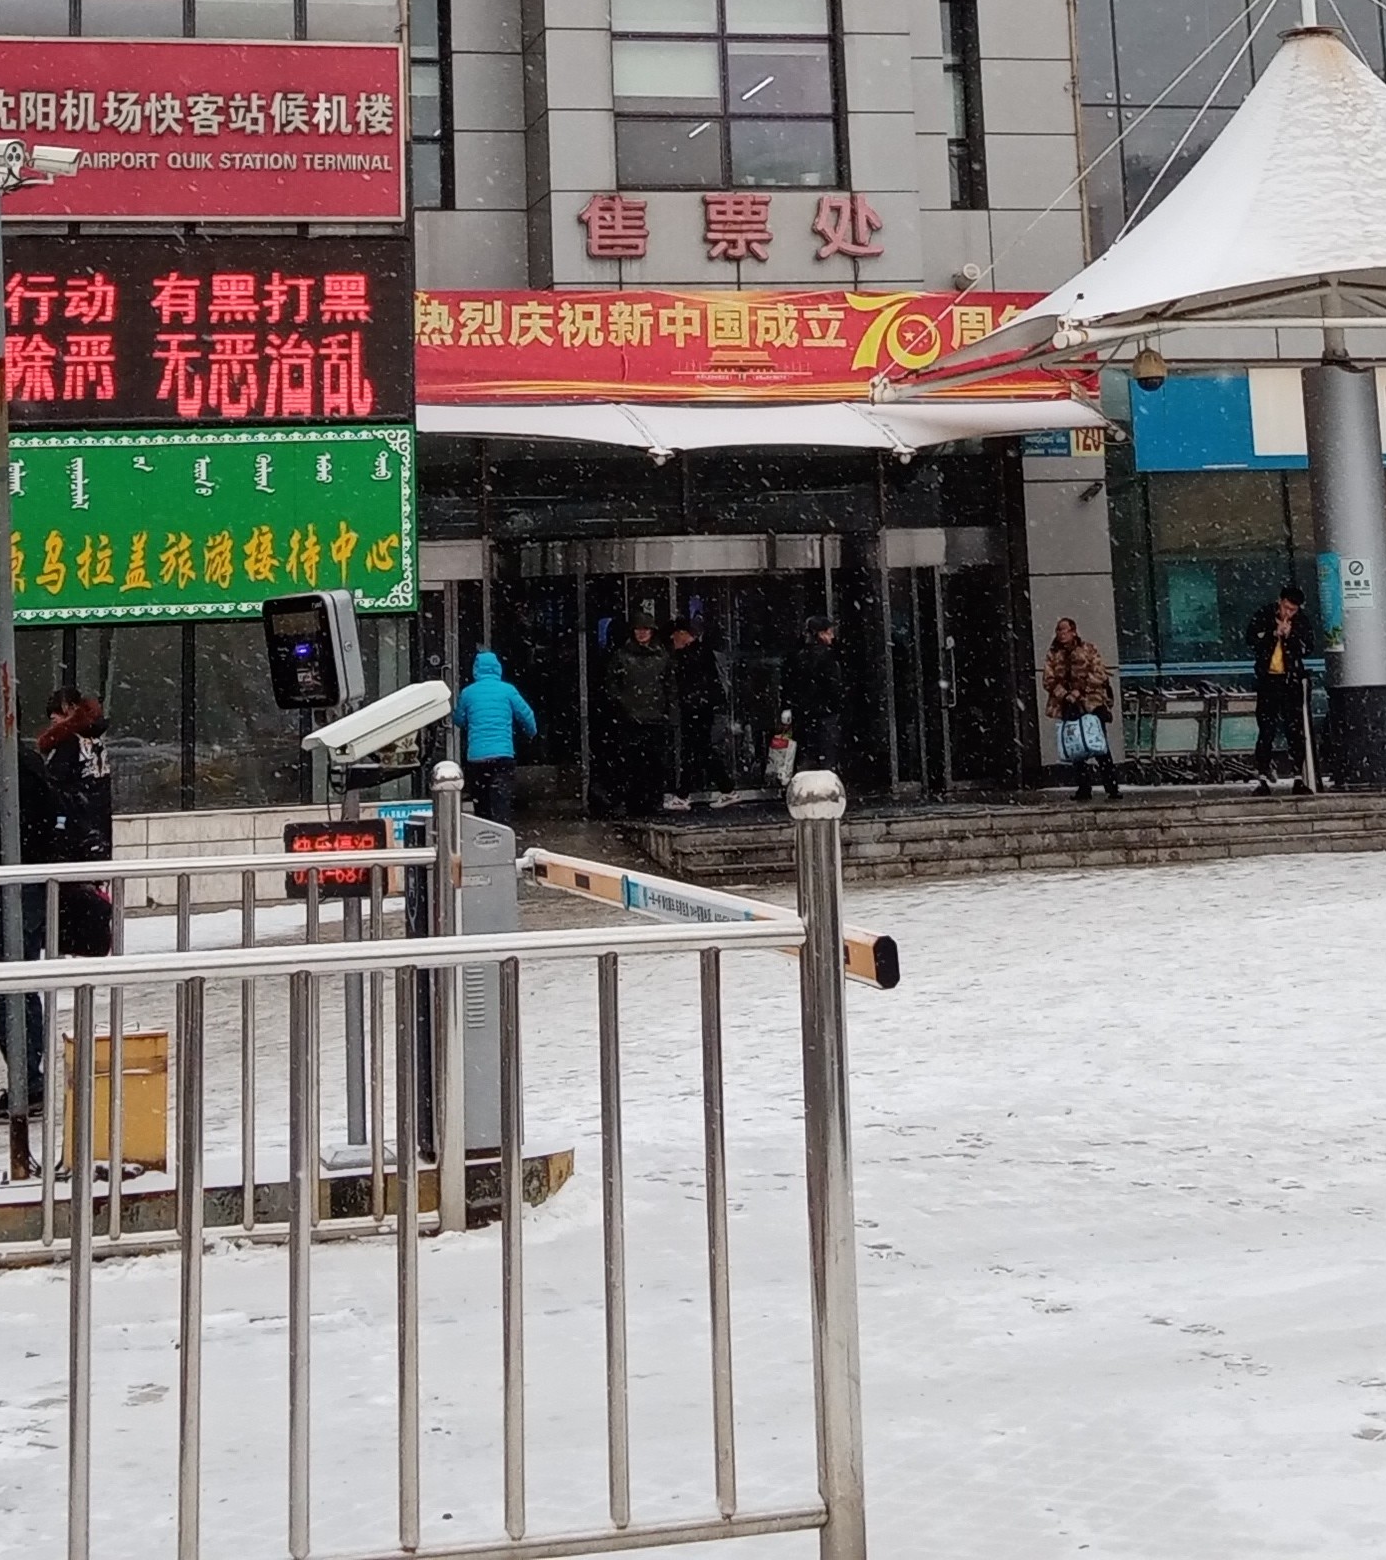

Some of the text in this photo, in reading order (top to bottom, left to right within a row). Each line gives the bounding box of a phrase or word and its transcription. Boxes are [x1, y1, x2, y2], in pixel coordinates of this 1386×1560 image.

[79, 152, 393, 172] AIRPORT QUIK STATION TERMINAL
[578, 192, 885, 261] 售票处
[150, 272, 371, 325] 有黑打黑
